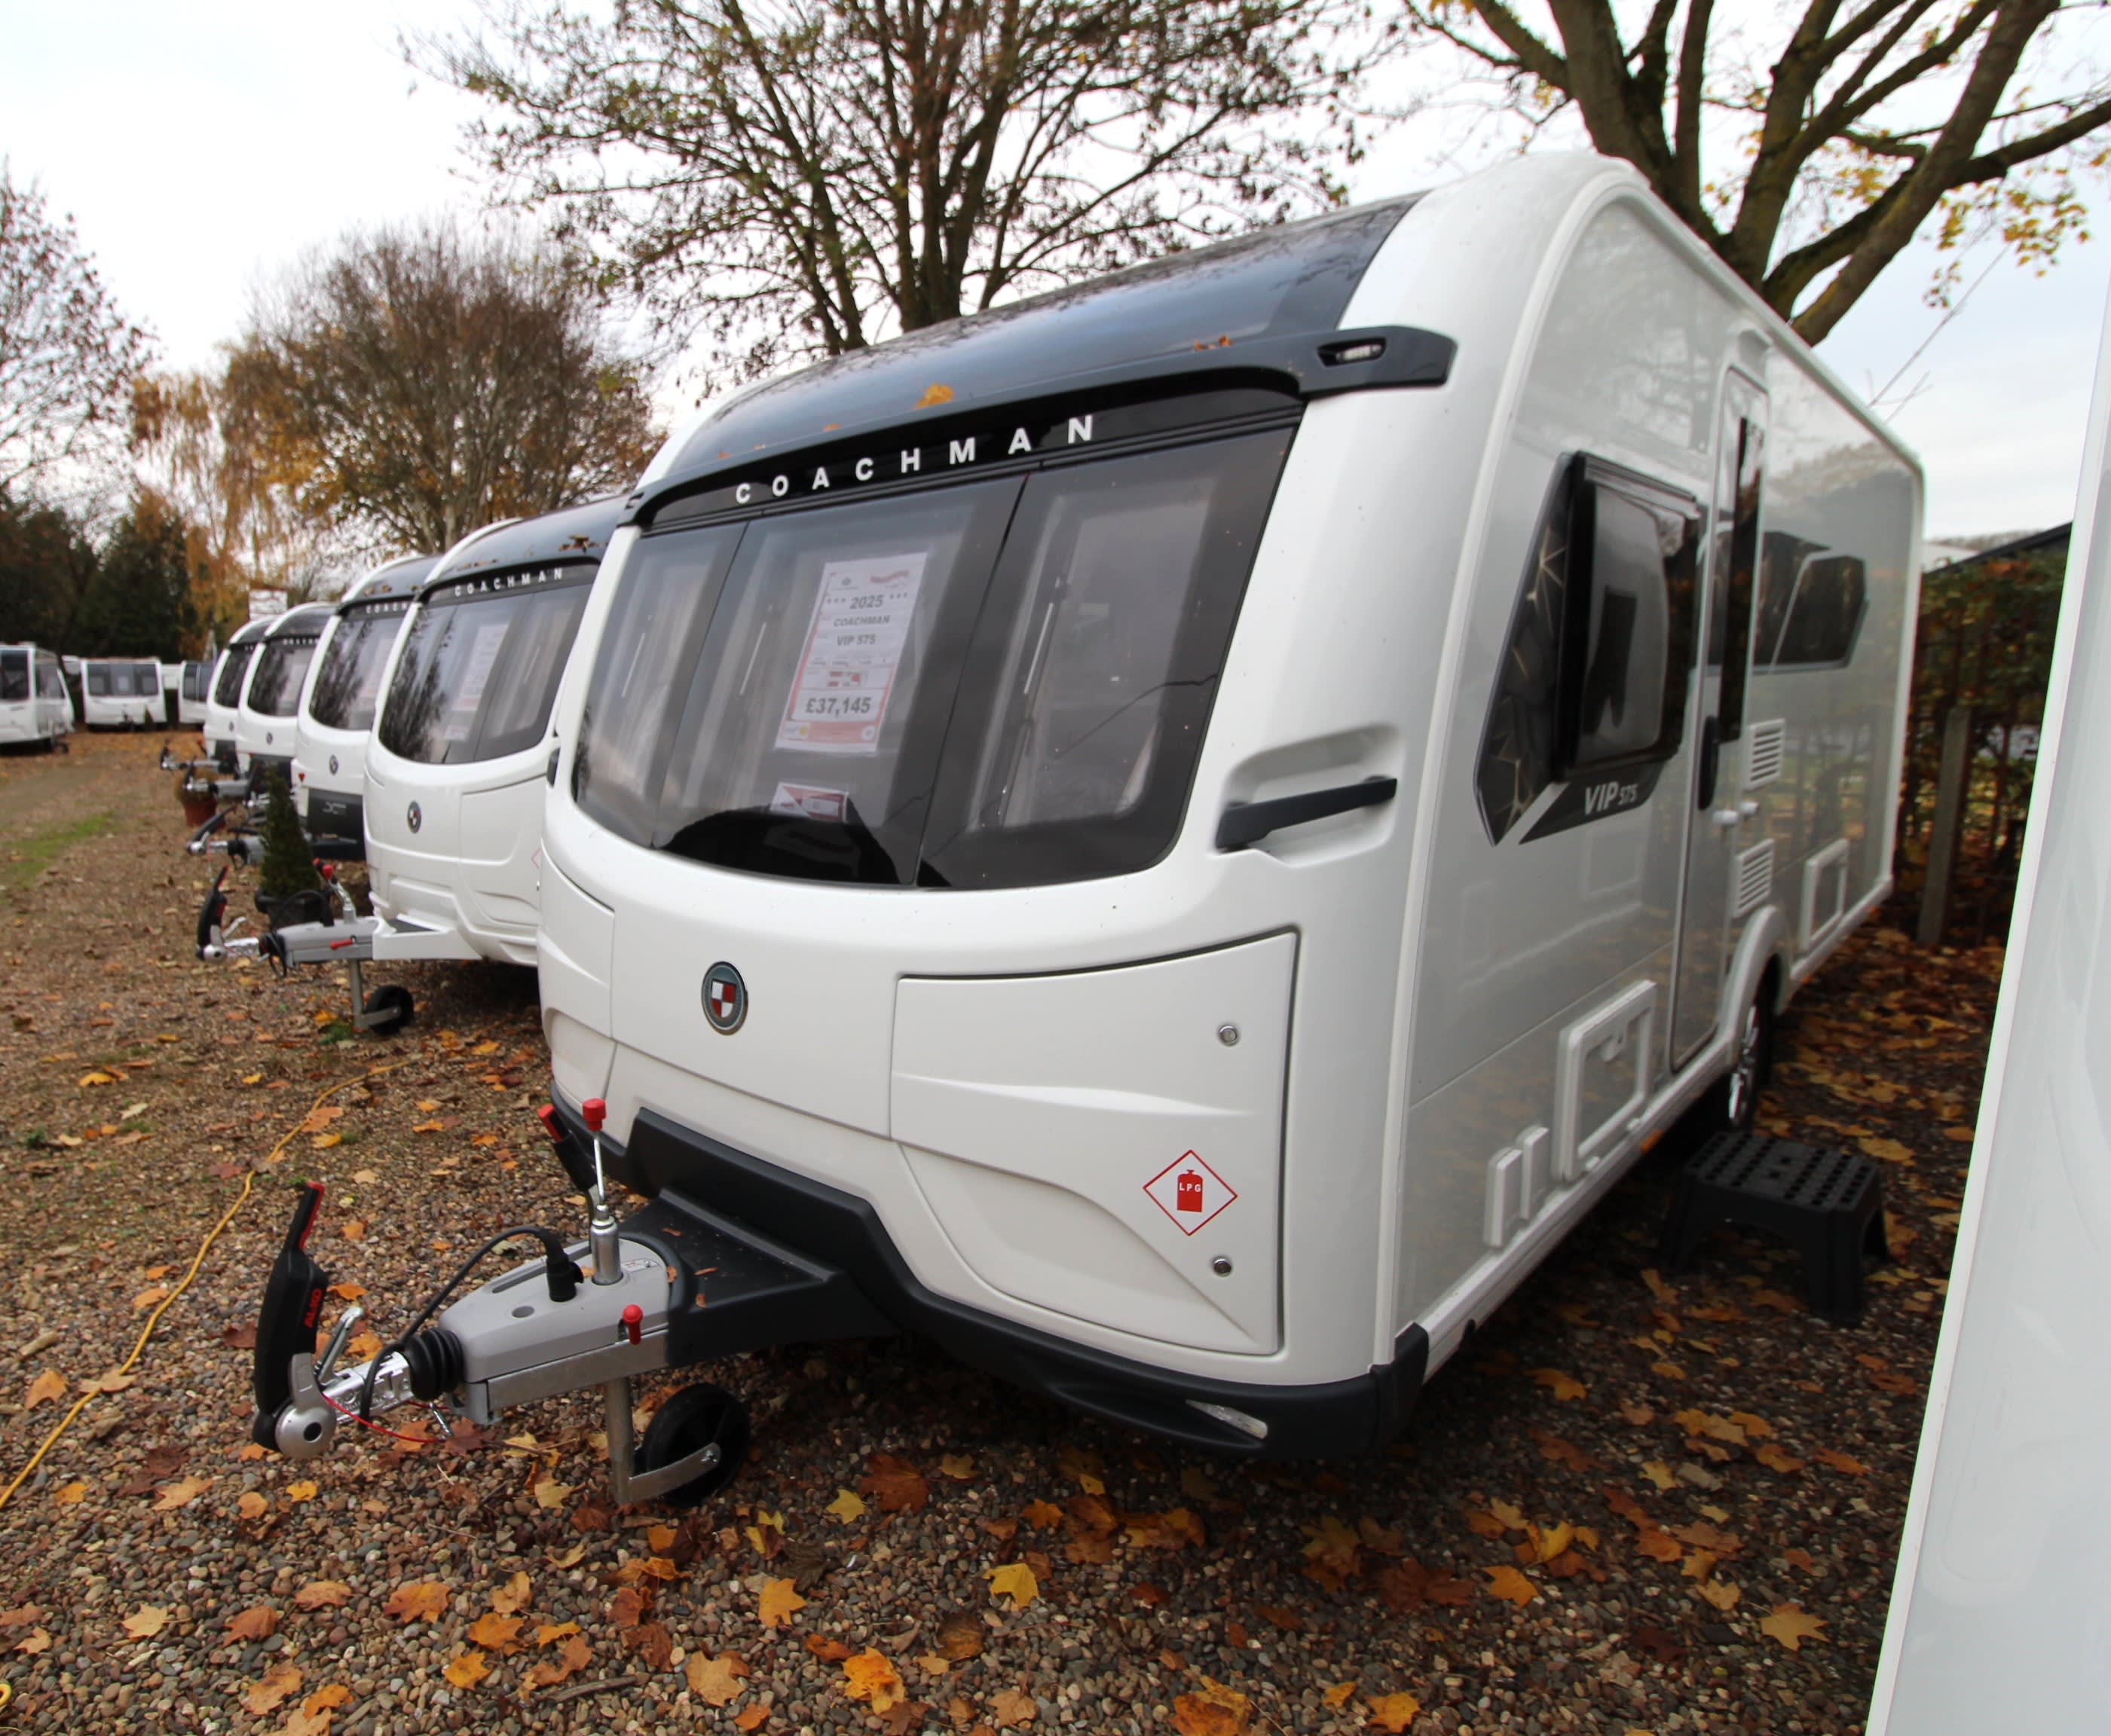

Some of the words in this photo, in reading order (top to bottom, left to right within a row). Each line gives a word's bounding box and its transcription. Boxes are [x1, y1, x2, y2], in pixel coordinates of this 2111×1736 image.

[735, 414, 1094, 504] COACHMAN
[454, 567, 563, 597] COACHMAN
[849, 594, 884, 610] 2025
[833, 614, 890, 627] COACHMAN
[837, 635, 855, 646] VIP
[857, 633, 877, 645] 575
[805, 696, 873, 718] £37,145
[1585, 781, 1619, 815] VIP
[1179, 1182, 1201, 1193] LPG
